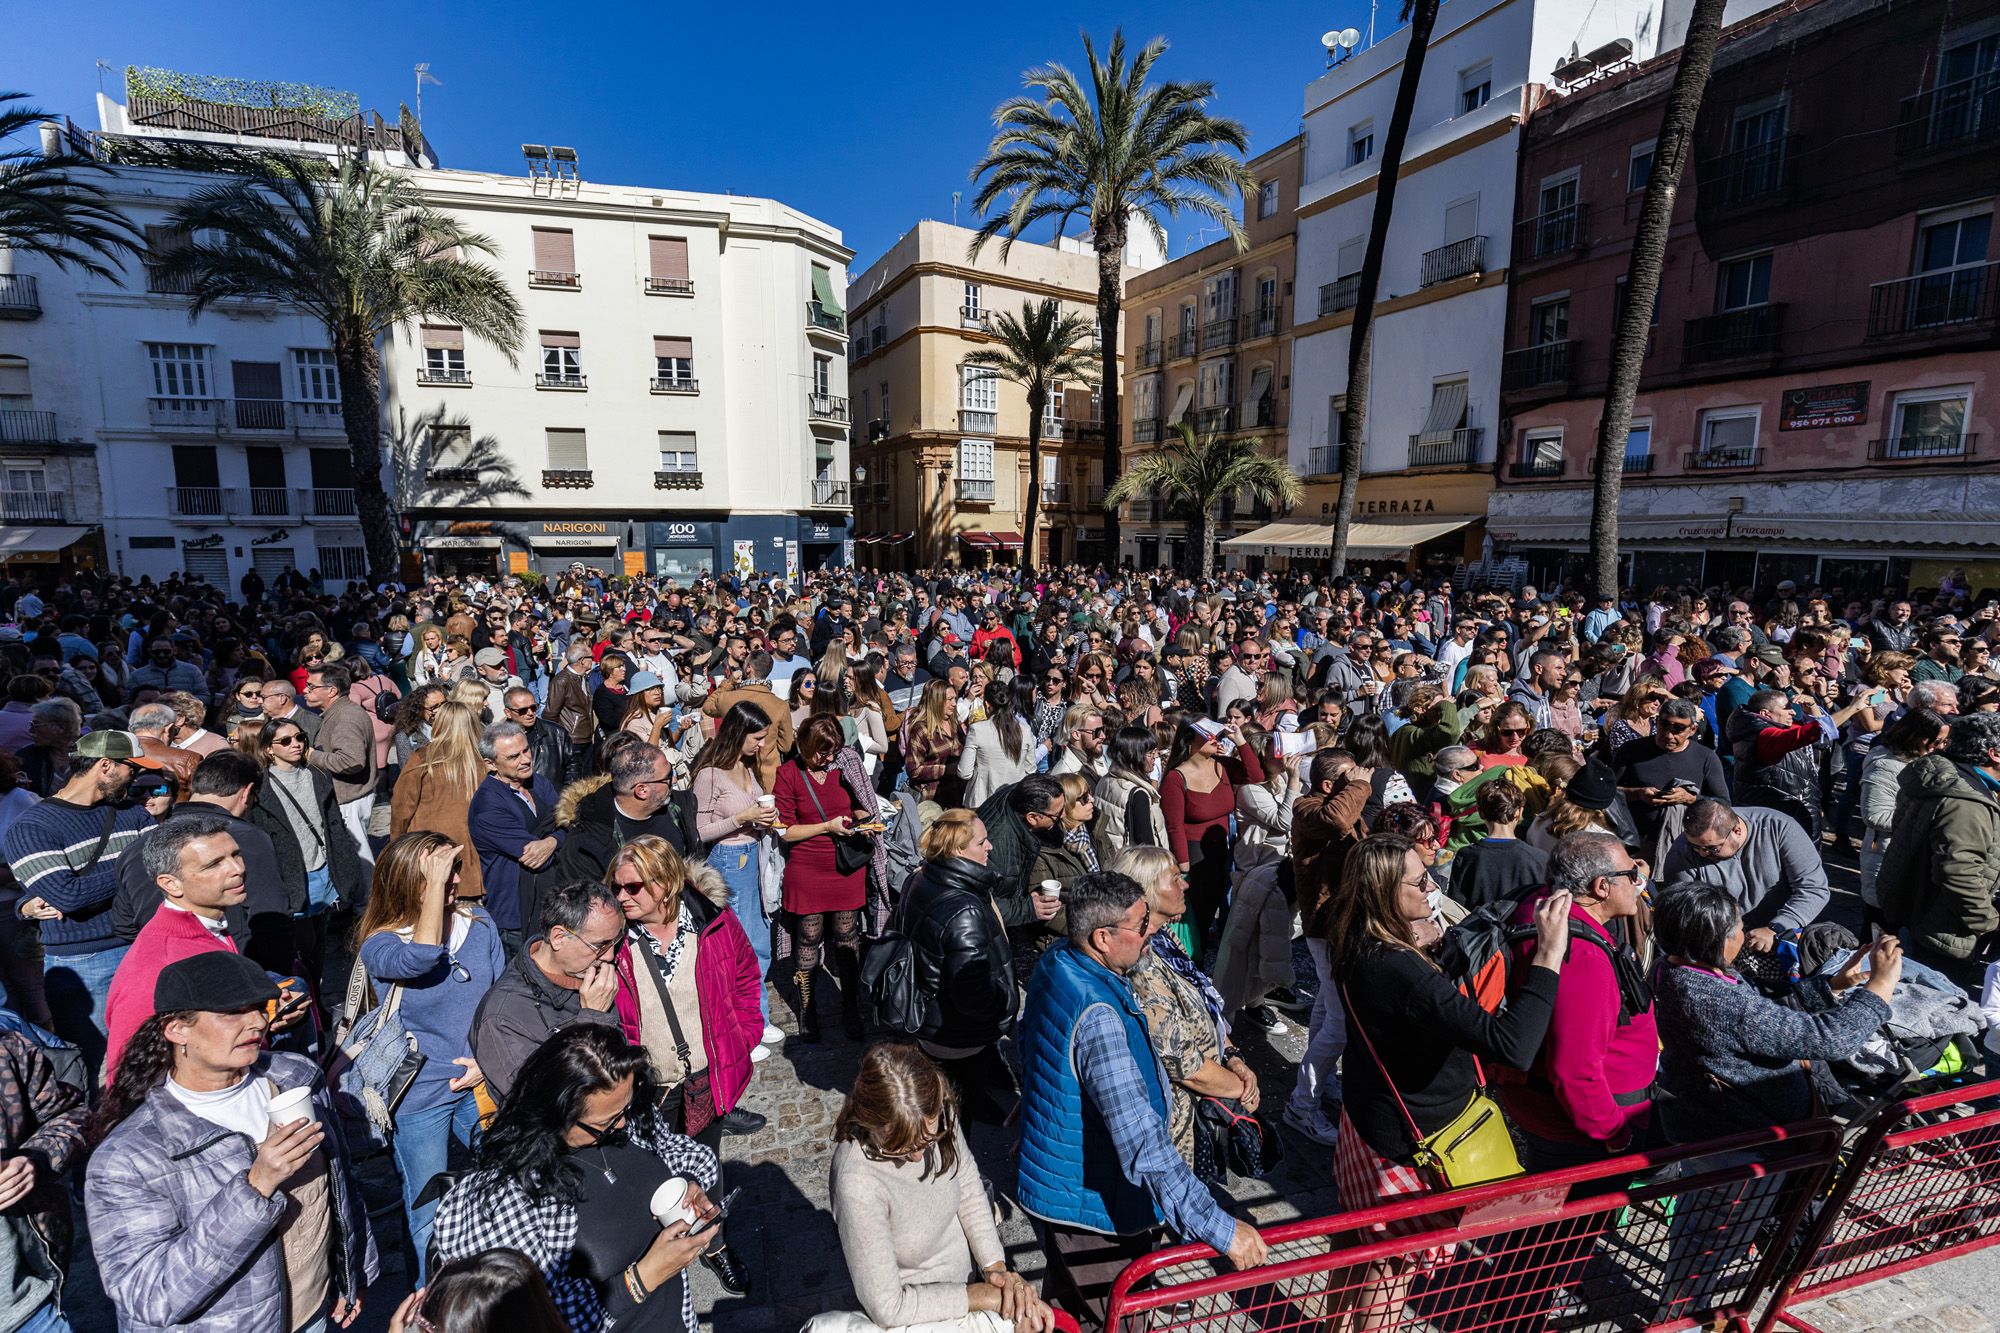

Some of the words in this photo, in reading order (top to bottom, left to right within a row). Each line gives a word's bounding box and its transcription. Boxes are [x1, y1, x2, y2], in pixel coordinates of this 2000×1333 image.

[1790, 419, 1809, 428] 956
[1833, 415, 1855, 423] 000
[1357, 499, 1435, 514] TERRAZA
[543, 522, 606, 533] NARIGONI
[668, 523, 695, 534] 100
[813, 522, 829, 532] 100
[1679, 526, 1724, 536] Cruzcampo
[1736, 526, 1785, 536] Cruzcampo
[1264, 546, 1277, 555] EL
[1288, 547, 1330, 556] TERRA
[353, 960, 364, 983] VUITT
[349, 984, 360, 1006] LOUIS
